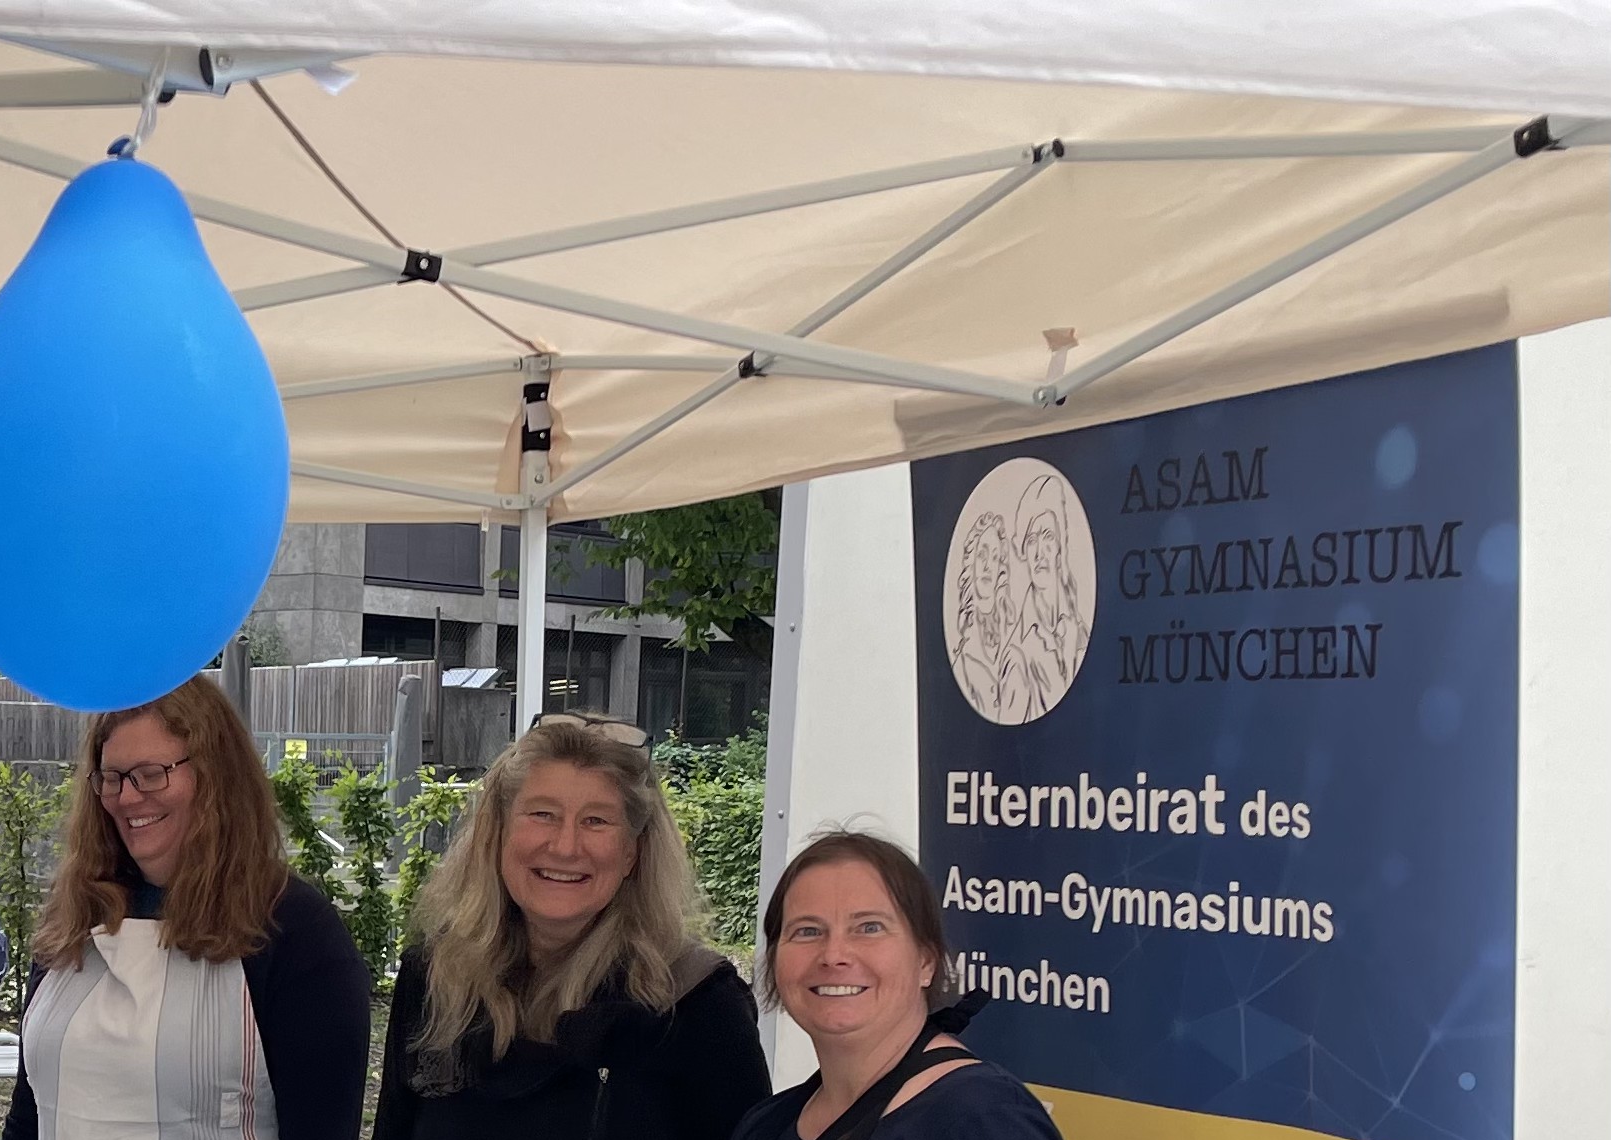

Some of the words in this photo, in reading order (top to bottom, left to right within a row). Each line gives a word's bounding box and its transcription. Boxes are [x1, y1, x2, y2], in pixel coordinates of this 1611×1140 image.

[1120, 447, 1269, 514] ASAM
[1118, 521, 1463, 600] GYMNASIUM
[1118, 620, 1383, 684] MÜNCHEN
[945, 771, 1226, 835] Elternbeirat
[1239, 789, 1311, 839] des
[941, 865, 1334, 942] Asam-Gymnasiums
